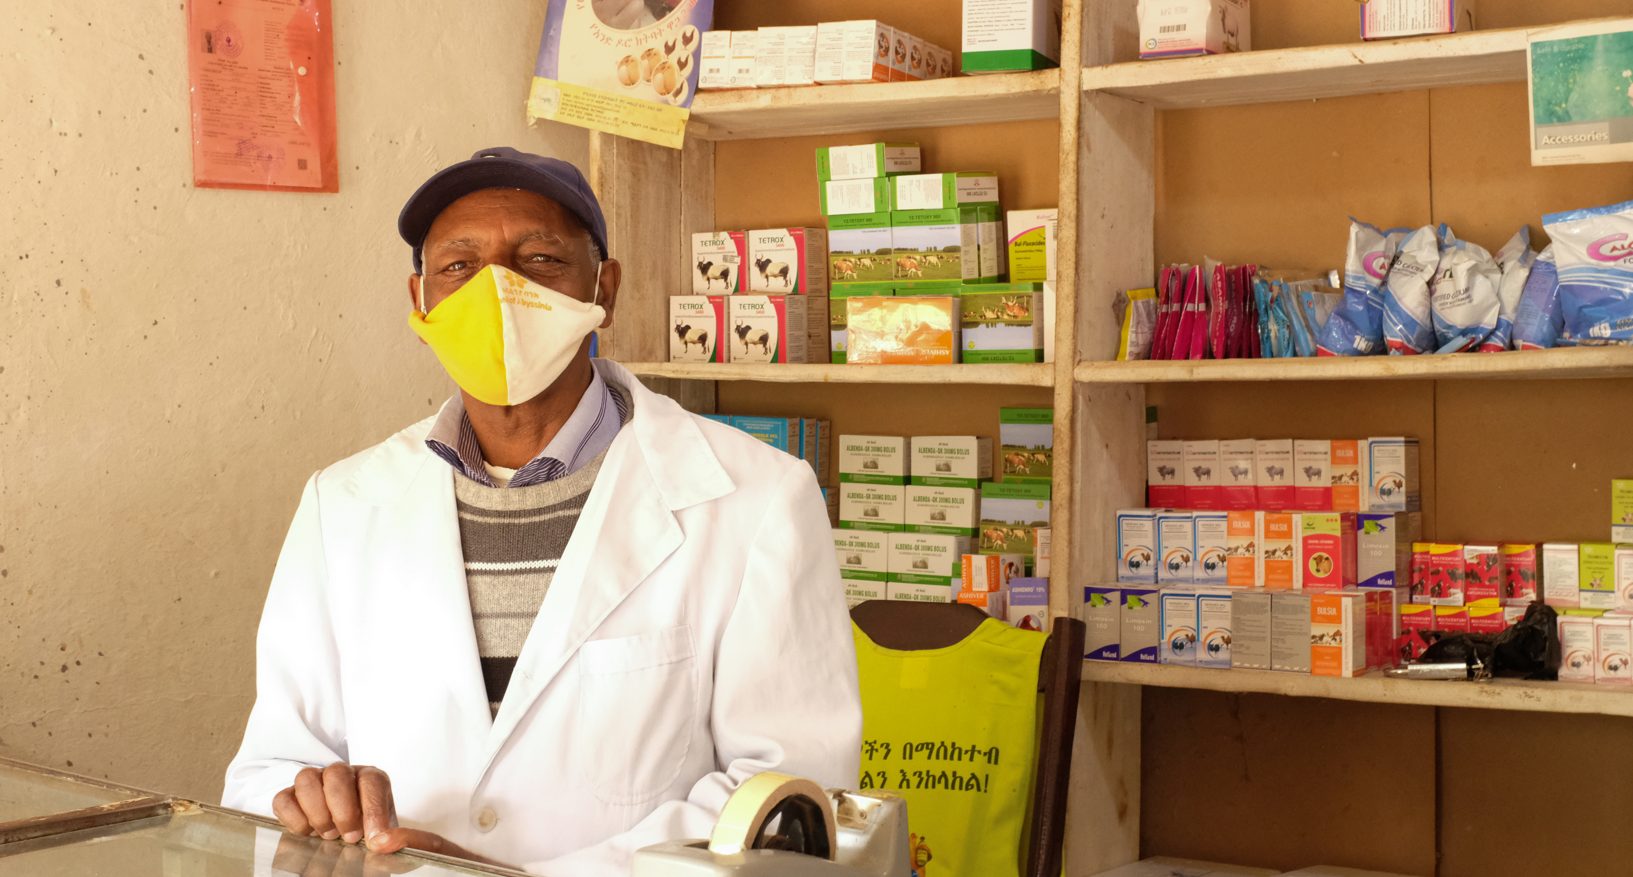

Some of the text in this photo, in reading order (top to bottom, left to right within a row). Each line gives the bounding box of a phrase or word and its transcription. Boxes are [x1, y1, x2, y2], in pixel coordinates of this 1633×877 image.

[1542, 130, 1609, 145] Accessories
[700, 238, 726, 248] TETROX
[758, 236, 785, 244] TETROX
[679, 302, 704, 310] TETROX
[739, 302, 765, 310] TETROX
[860, 739, 892, 761] ችን
